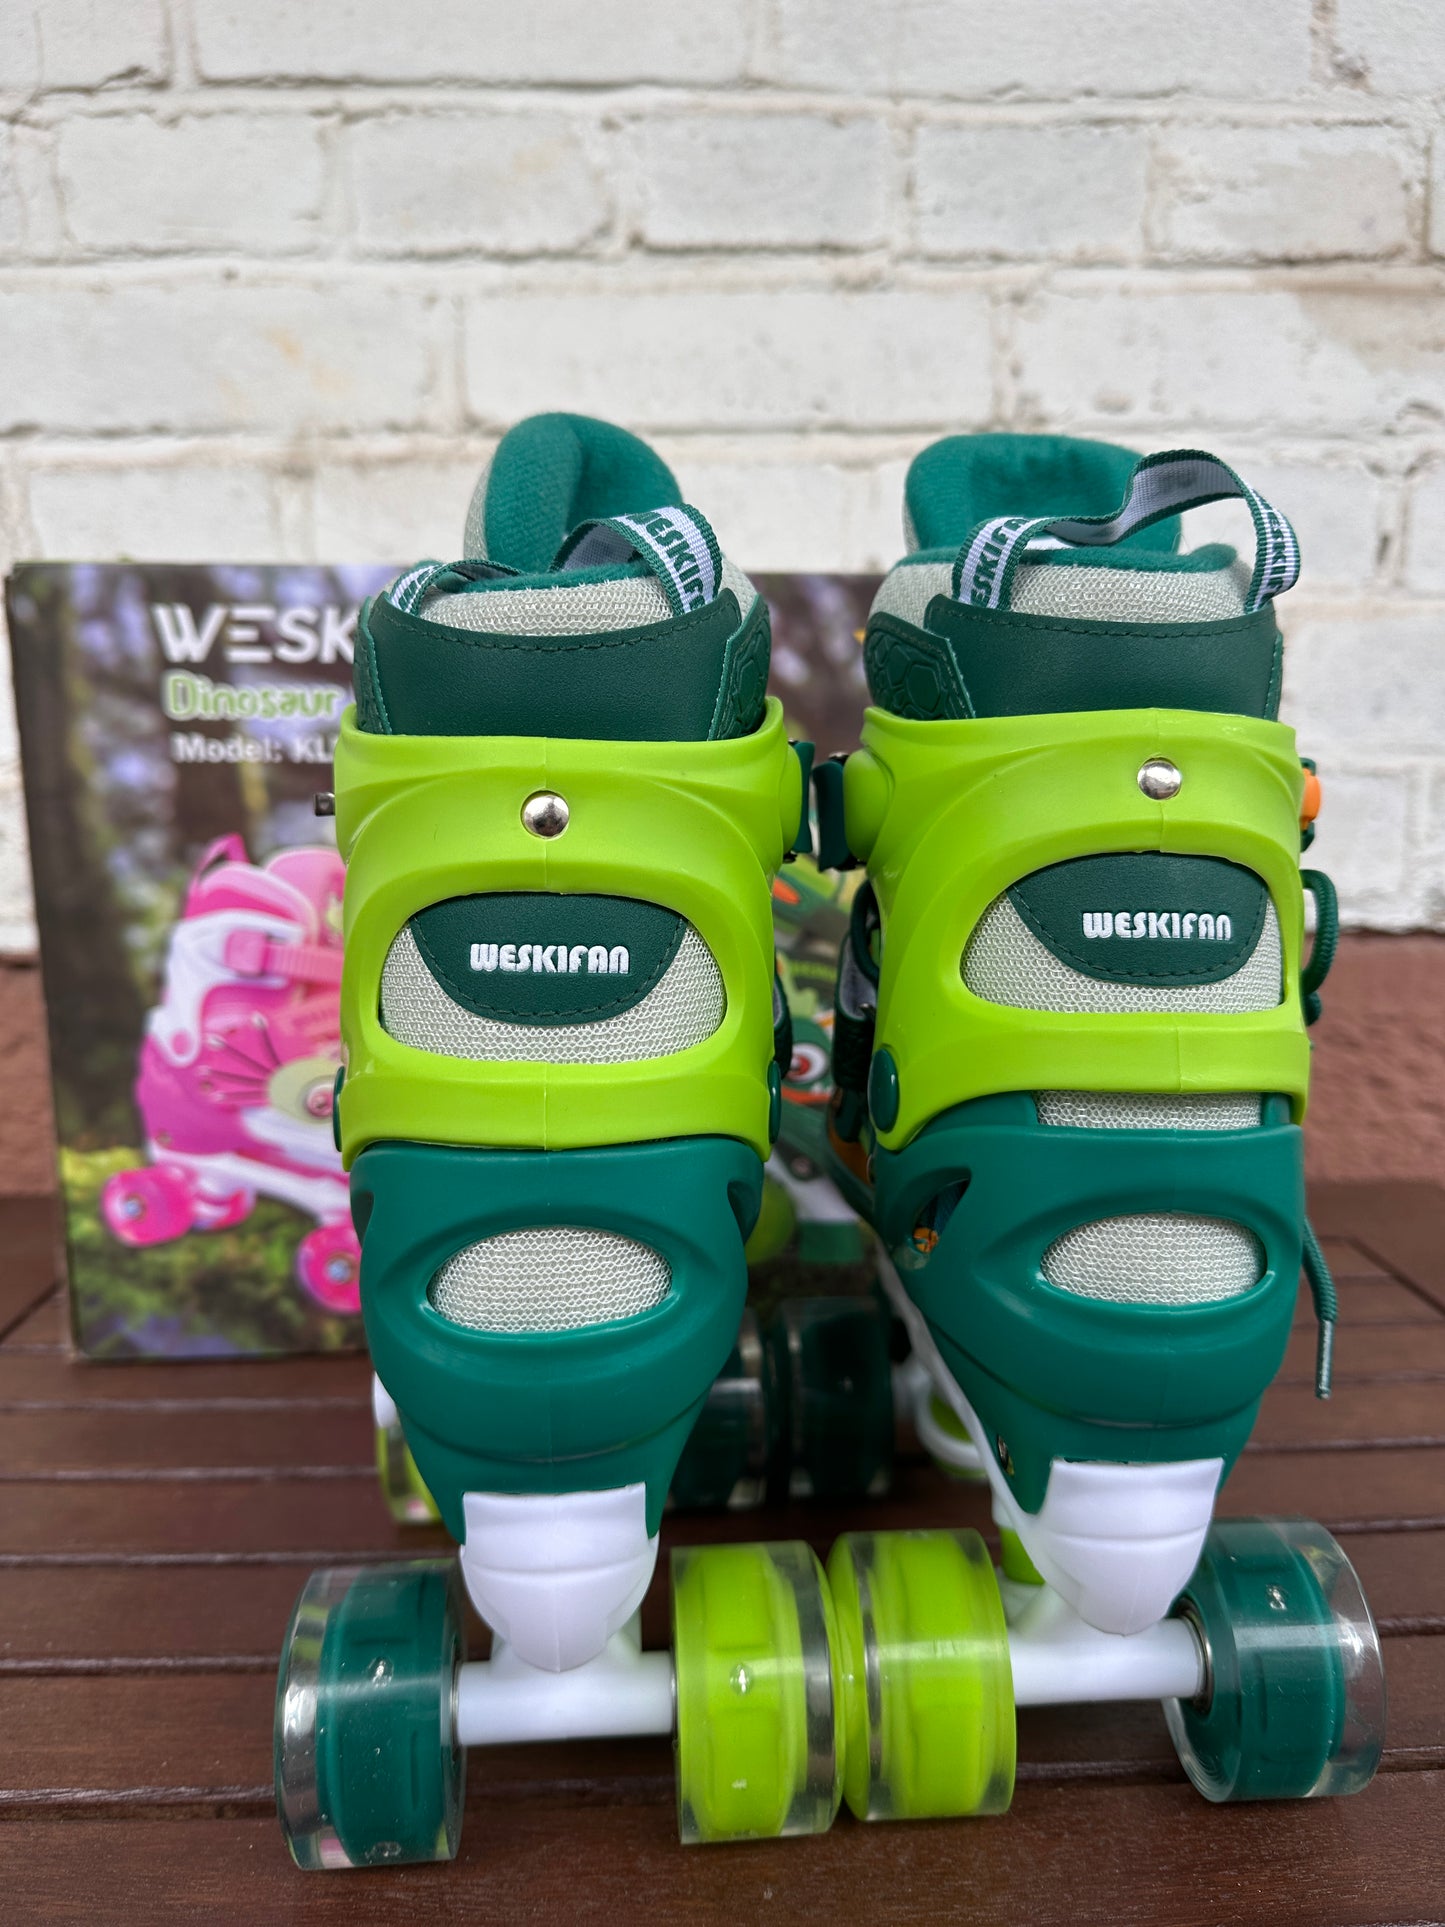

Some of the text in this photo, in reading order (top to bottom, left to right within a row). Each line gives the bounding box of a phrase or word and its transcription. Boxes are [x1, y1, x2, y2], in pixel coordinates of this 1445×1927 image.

[163, 669, 343, 720] Dinosaur
[173, 733, 338, 764] Model: KL
